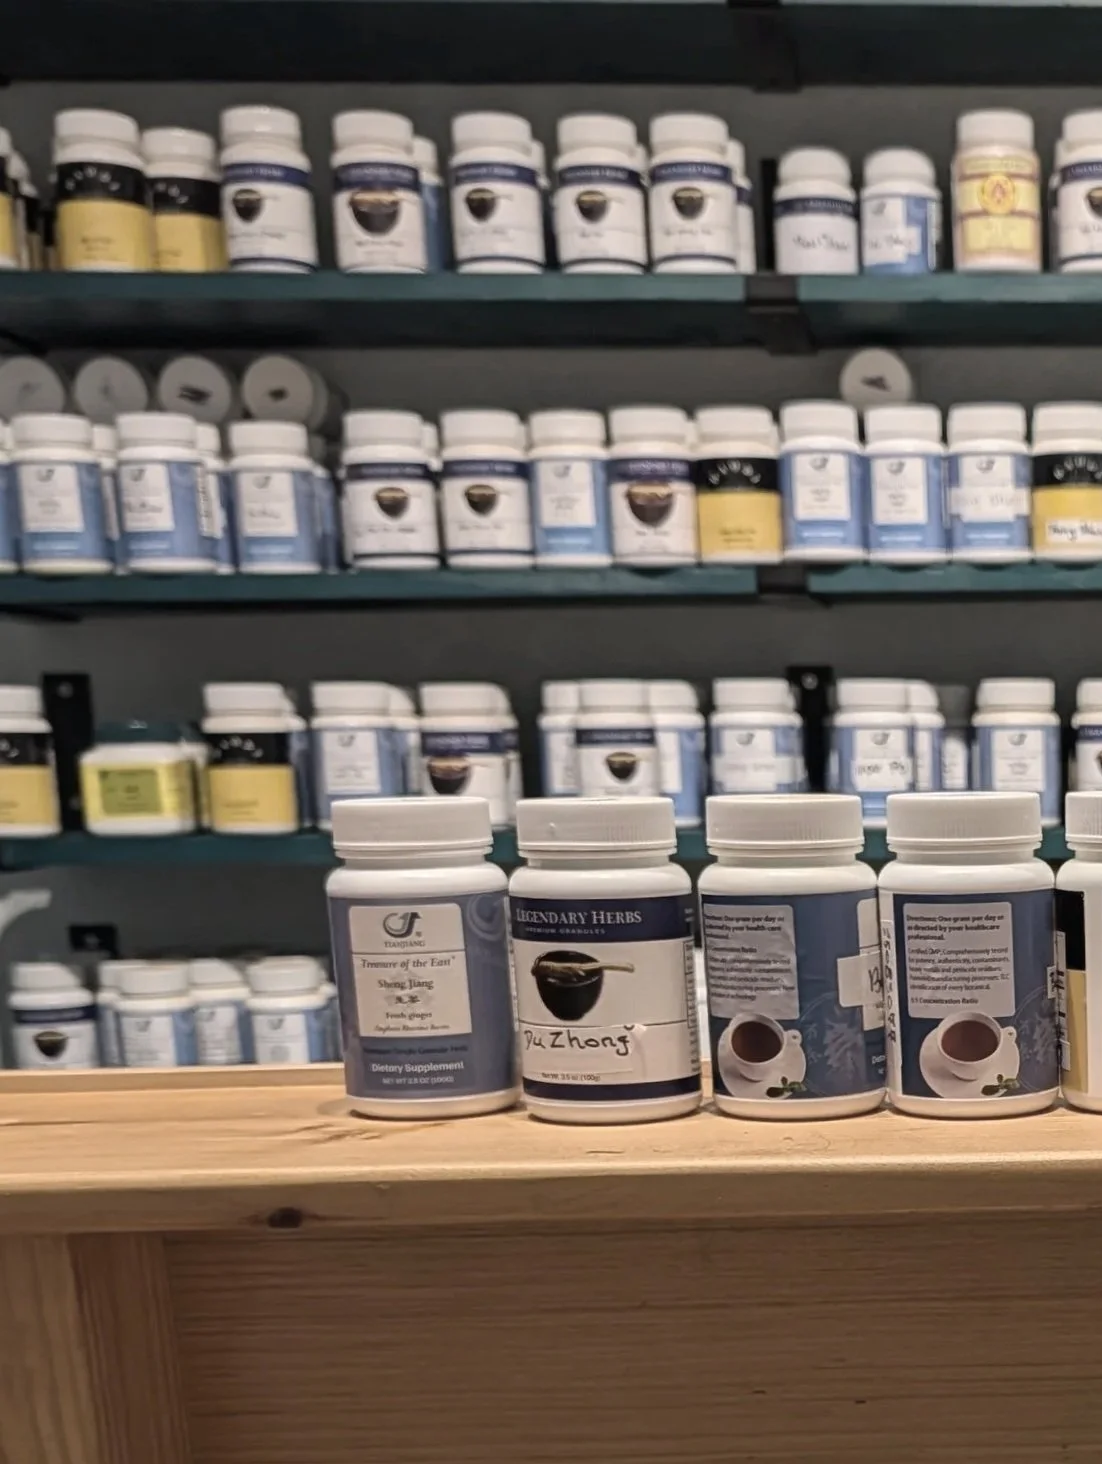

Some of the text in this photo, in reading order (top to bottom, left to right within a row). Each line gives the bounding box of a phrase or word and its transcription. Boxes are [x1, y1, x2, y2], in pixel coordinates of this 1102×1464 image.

[516, 908, 642, 925] LEGENDARY HERBS
[984, 914, 997, 922] day
[400, 958, 409, 971] of
[412, 959, 427, 968] the
[377, 979, 434, 990] Sheng Jiang
[372, 1060, 464, 1073] Dietary Supplement
